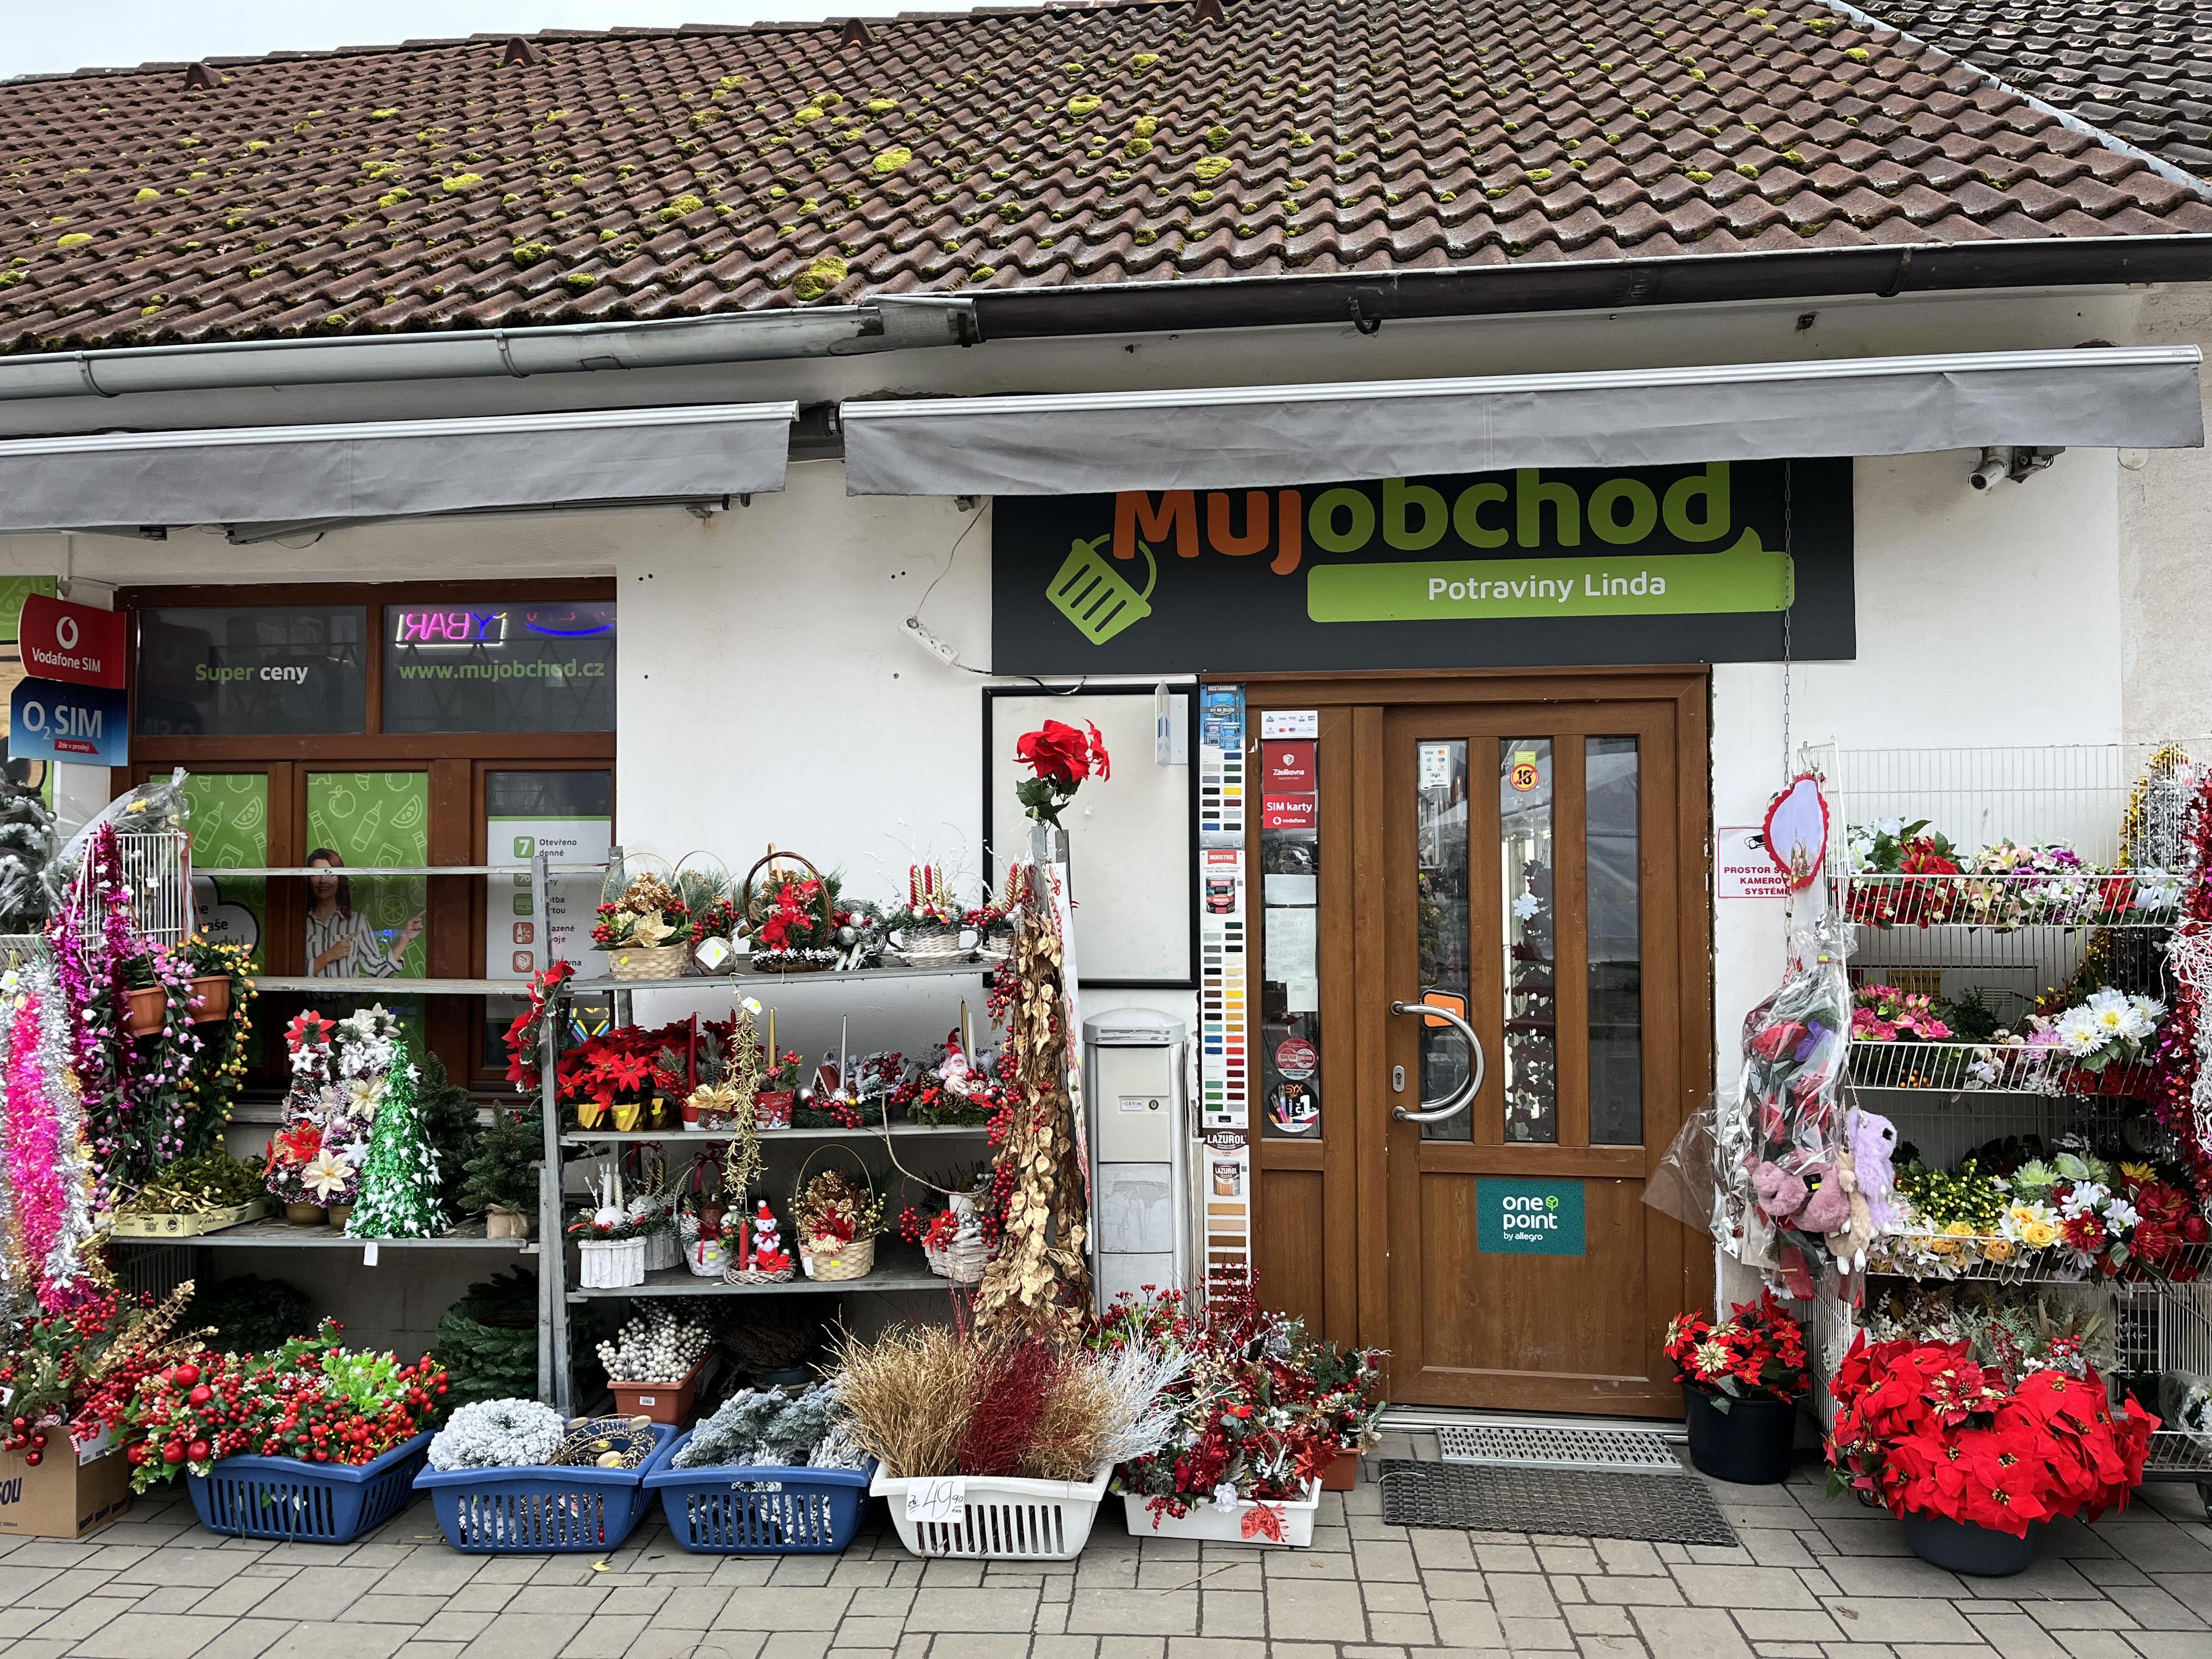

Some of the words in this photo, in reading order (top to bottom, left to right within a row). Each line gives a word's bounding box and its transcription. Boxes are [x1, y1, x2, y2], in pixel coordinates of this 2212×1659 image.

[1427, 573, 1574, 602] Potraviny
[1584, 570, 1666, 597] Linda
[32, 647, 80, 669] Vodafone
[81, 656, 101, 673] SIM
[195, 664, 254, 685] Super
[259, 665, 309, 685] ceny
[399, 658, 605, 682] www.mujobchod.cz
[54, 705, 102, 739] SIM
[1517, 769, 1532, 785] 18
[1266, 802, 1285, 811] SIM
[1287, 802, 1312, 813] karty
[1285, 1084, 1303, 1093] SYX
[1207, 1134, 1246, 1144] LAZUROL
[1502, 1196, 1543, 1211] one
[1503, 1213, 1558, 1230] point
[1504, 1232, 1514, 1241] by
[1515, 1232, 1543, 1242] allegro
[922, 1480, 954, 1520] 49
[952, 1494, 963, 1504] 90
